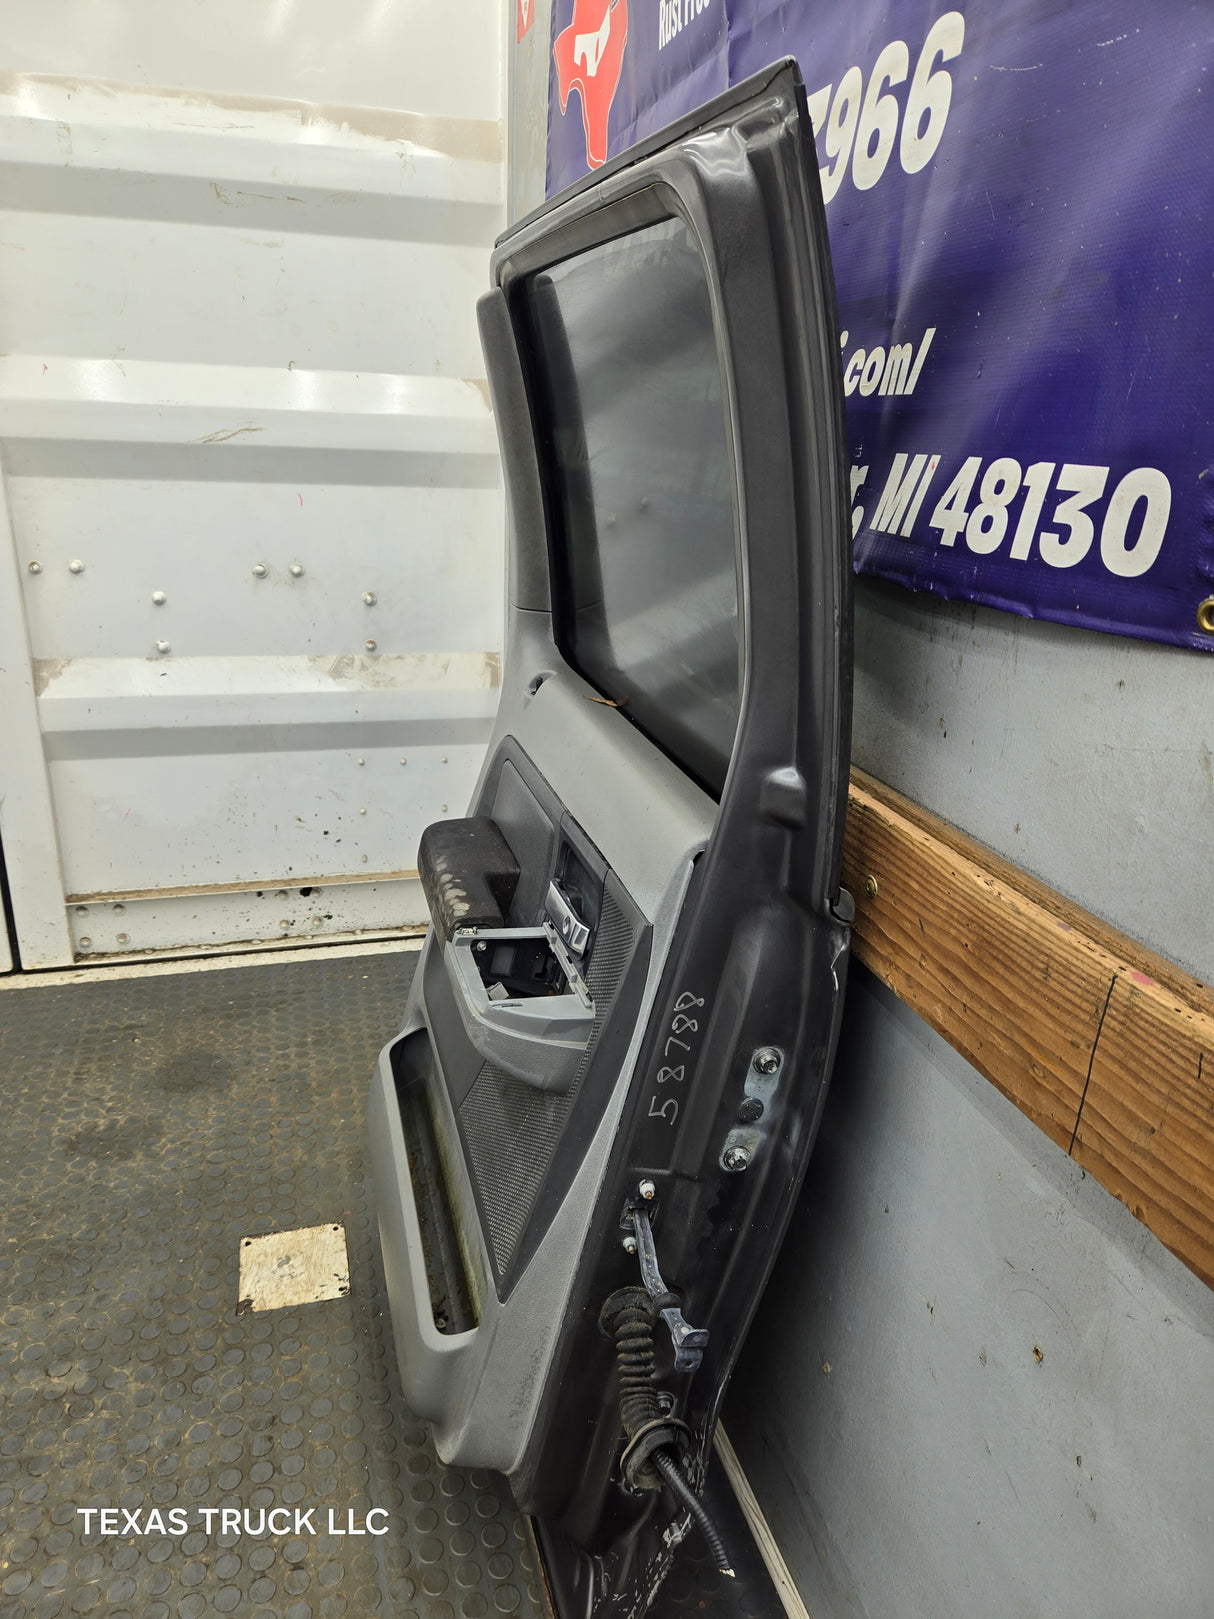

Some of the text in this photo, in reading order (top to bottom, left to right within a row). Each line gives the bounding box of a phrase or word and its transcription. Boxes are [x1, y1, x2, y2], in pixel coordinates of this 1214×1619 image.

[658, 0, 683, 51] Rust
[869, 453, 941, 538] MI
[928, 456, 1172, 578] 48130
[648, 991, 705, 1125] 58788
